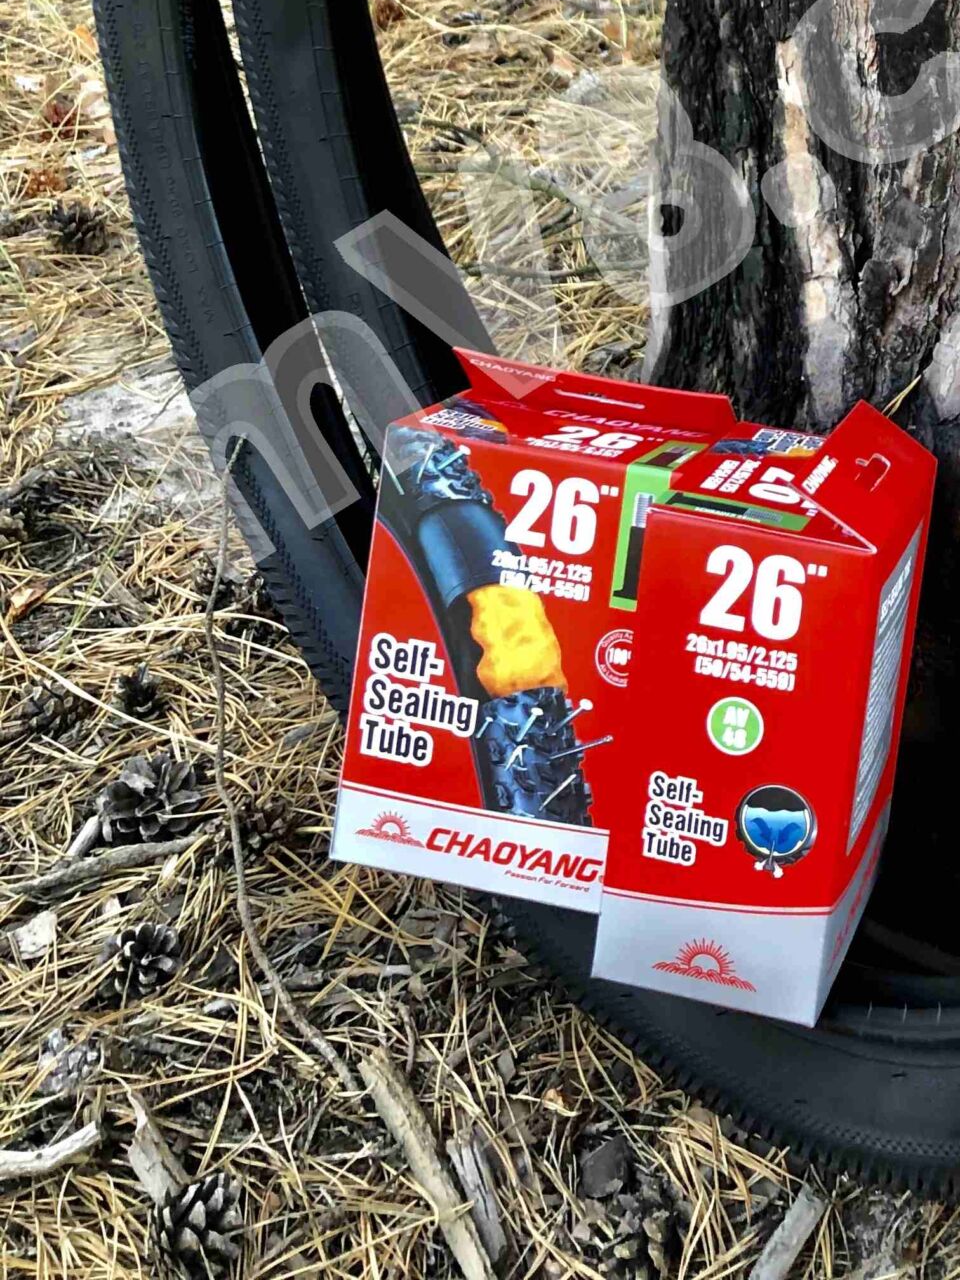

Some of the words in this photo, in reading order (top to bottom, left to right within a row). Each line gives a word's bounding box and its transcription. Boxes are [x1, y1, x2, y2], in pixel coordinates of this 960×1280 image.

[542, 408, 713, 439] CHAOYANG
[371, 634, 442, 681] Self-
[367, 676, 477, 735] Sealing
[362, 716, 431, 765] Tube
[650, 773, 702, 805] Self-
[647, 801, 727, 845] Sealing
[425, 827, 604, 884] CHAOYANG
[645, 829, 695, 864] Tube
